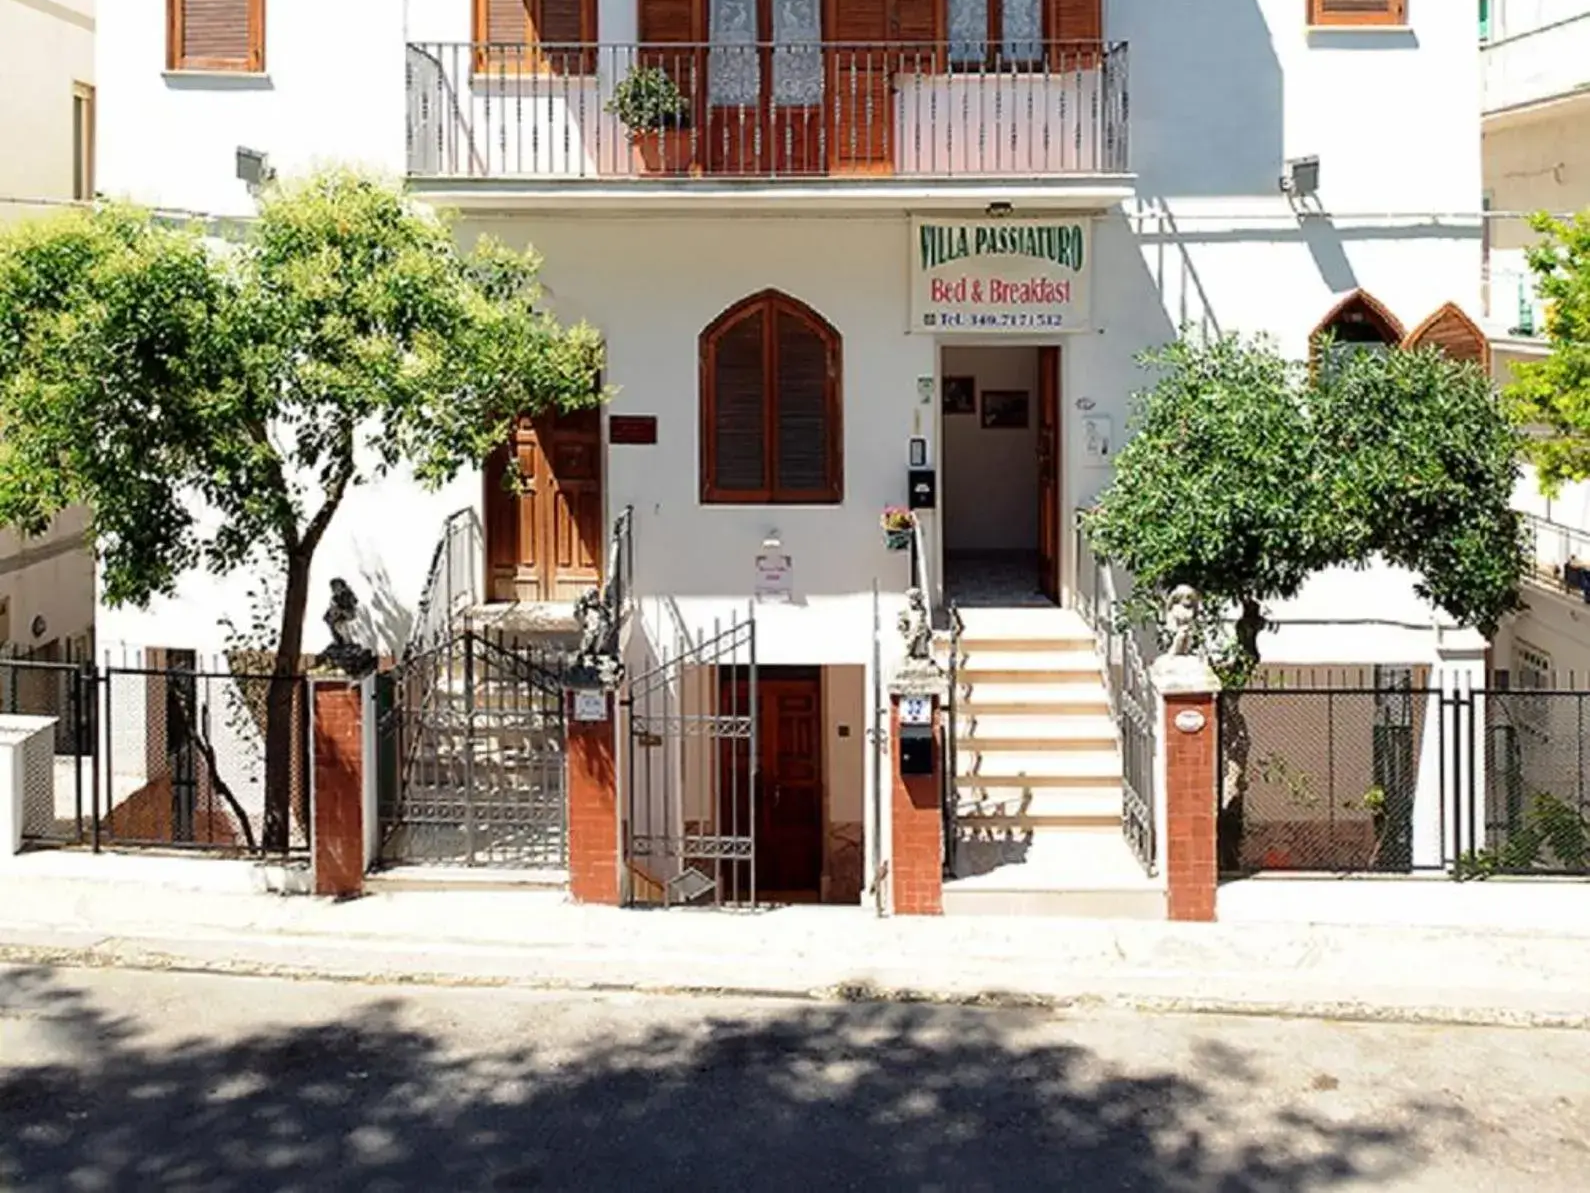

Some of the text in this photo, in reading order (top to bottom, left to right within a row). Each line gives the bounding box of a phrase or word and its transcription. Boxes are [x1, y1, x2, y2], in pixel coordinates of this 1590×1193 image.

[920, 225, 1083, 272] VILLA PASSIATURO
[931, 278, 1069, 304] Bed & Breakfast
